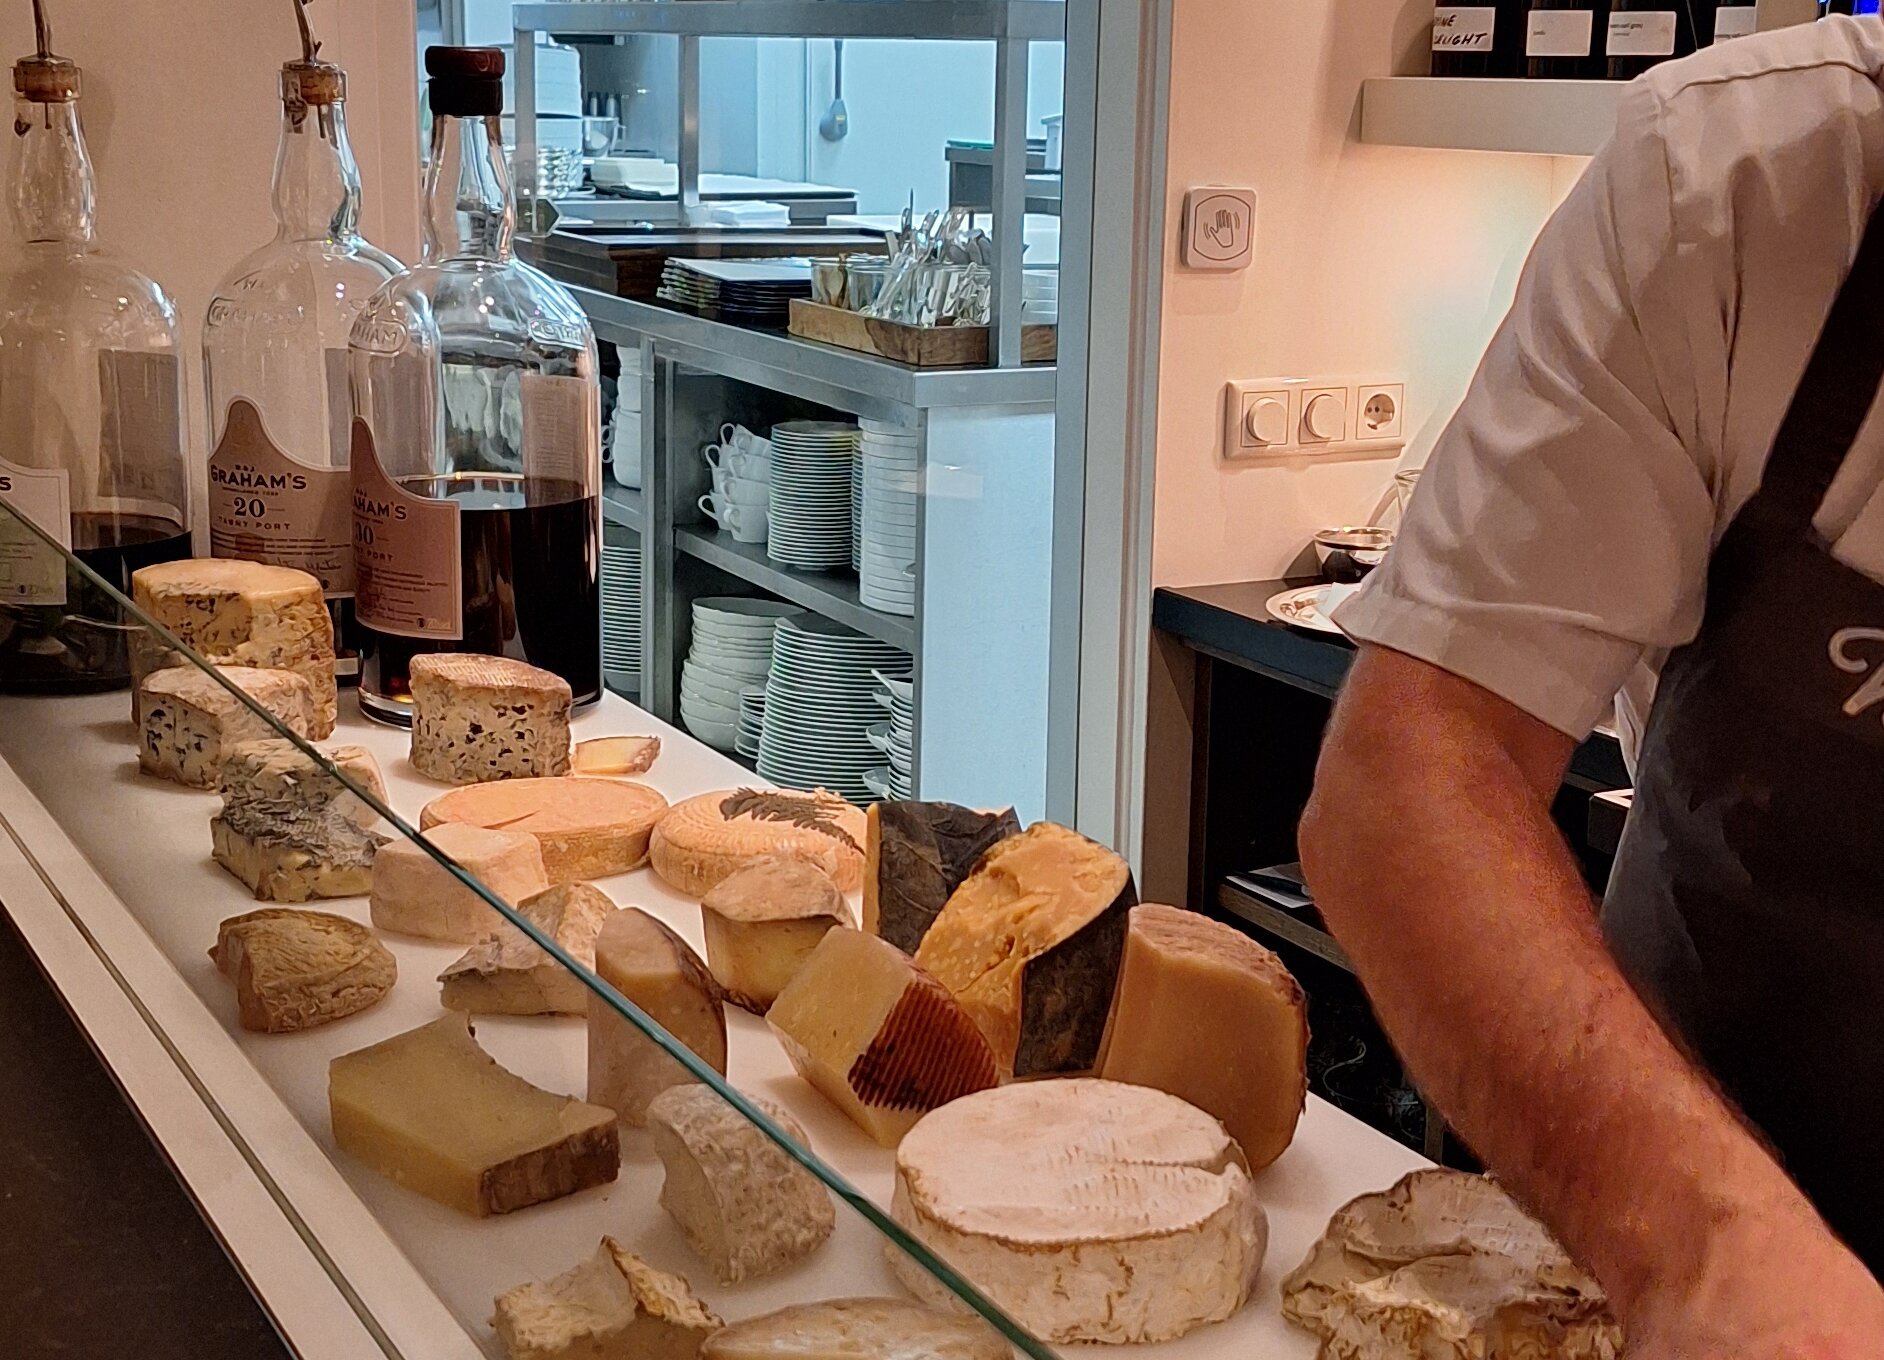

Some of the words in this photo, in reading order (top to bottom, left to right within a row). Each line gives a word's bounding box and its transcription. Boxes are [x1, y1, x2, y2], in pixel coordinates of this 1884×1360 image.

[210, 464, 307, 490] GRAHAM'S
[233, 496, 266, 518] 20
[255, 522, 291, 531] PORT
